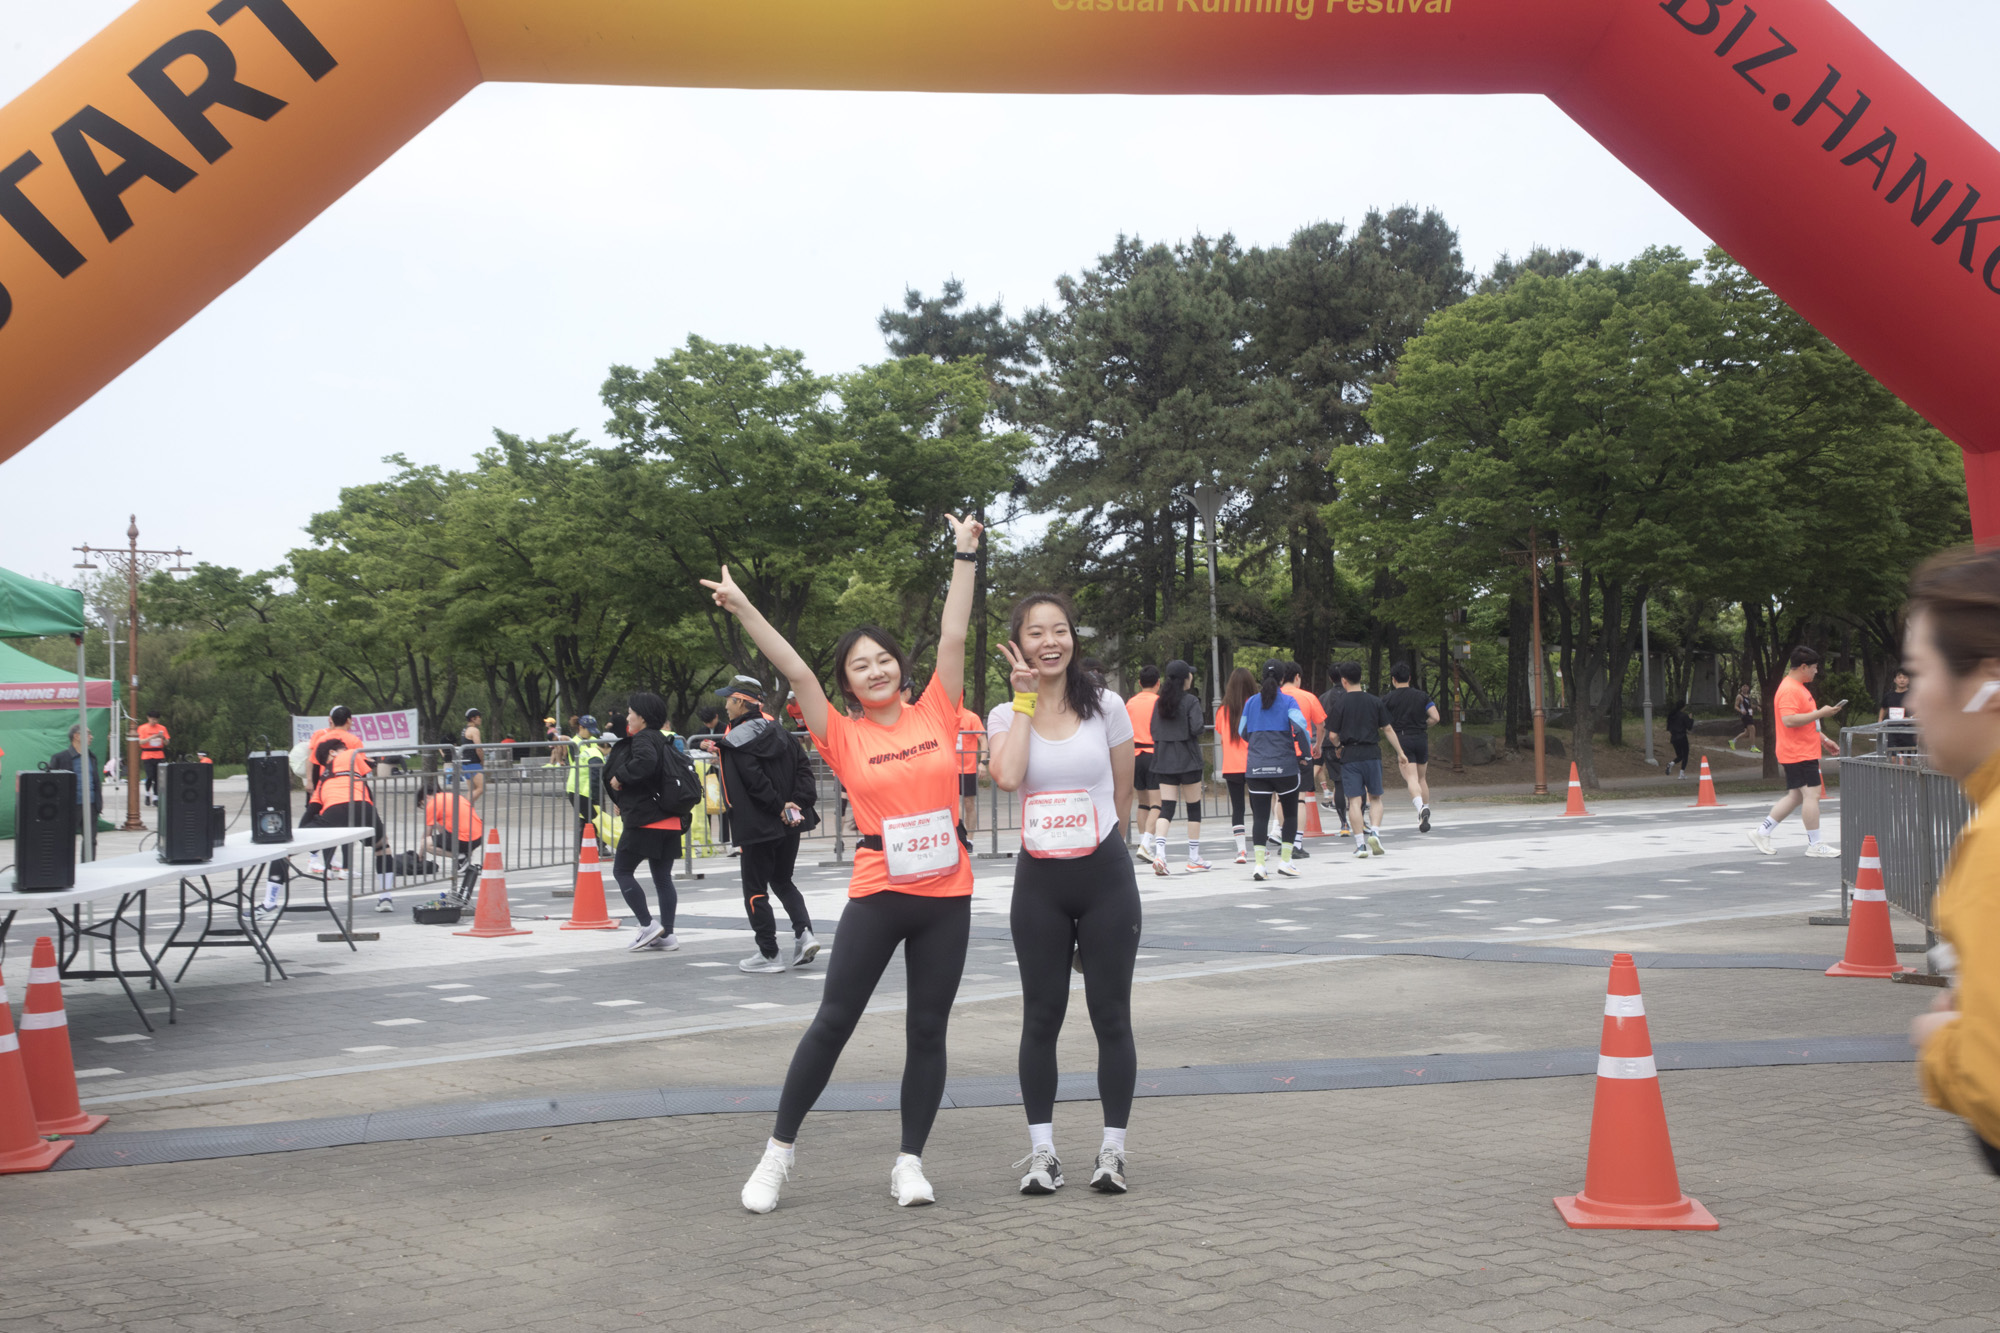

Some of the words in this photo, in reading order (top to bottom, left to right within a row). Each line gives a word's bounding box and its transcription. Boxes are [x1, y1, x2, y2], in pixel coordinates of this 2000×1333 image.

[0, 0, 338, 331] TART
[869, 745, 917, 764] BURNING
[918, 739, 938, 751] RUN
[1029, 818, 1039, 828] W
[1041, 813, 1088, 830] 3220
[892, 842, 904, 853] W
[907, 832, 951, 852] 3219
